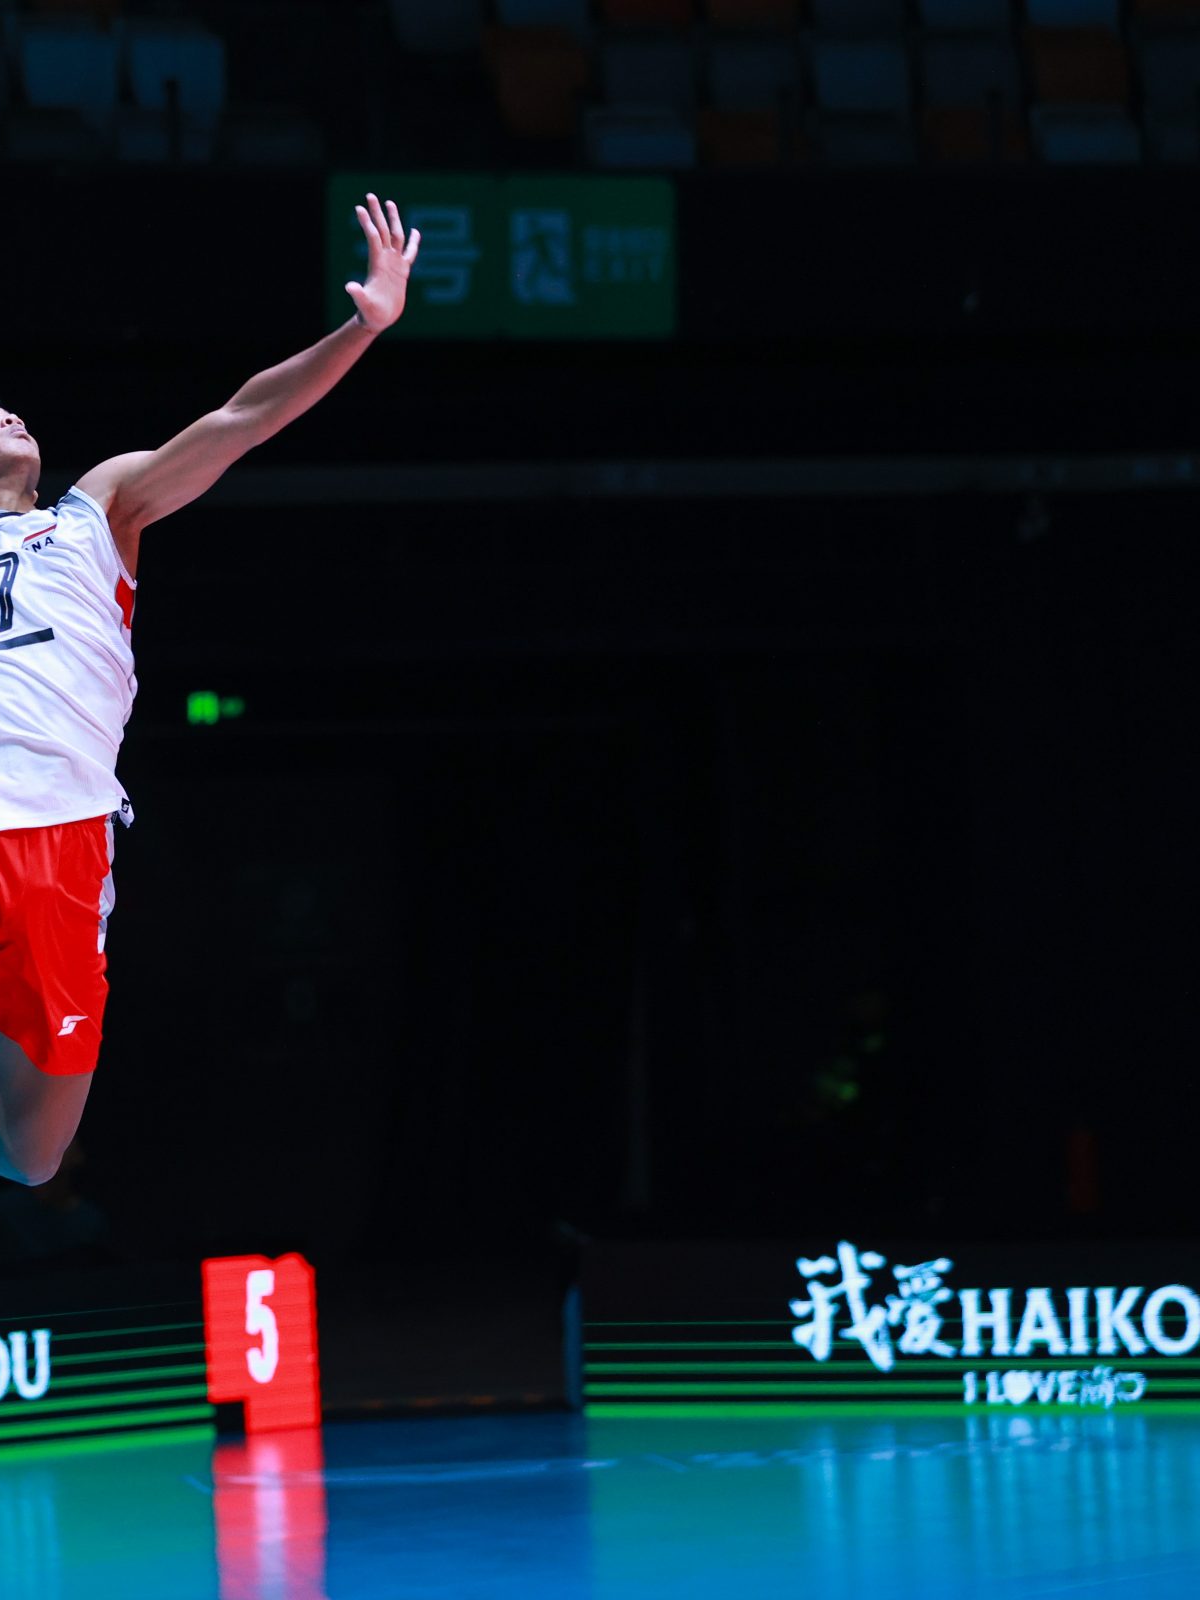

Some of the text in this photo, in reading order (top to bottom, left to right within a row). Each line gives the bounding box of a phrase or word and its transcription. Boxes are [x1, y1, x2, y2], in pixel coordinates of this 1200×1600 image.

[25, 536, 54, 553] NA
[246, 1269, 279, 1383] 5
[958, 1284, 1200, 1356] HAIKO
[963, 1370, 977, 1404] I
